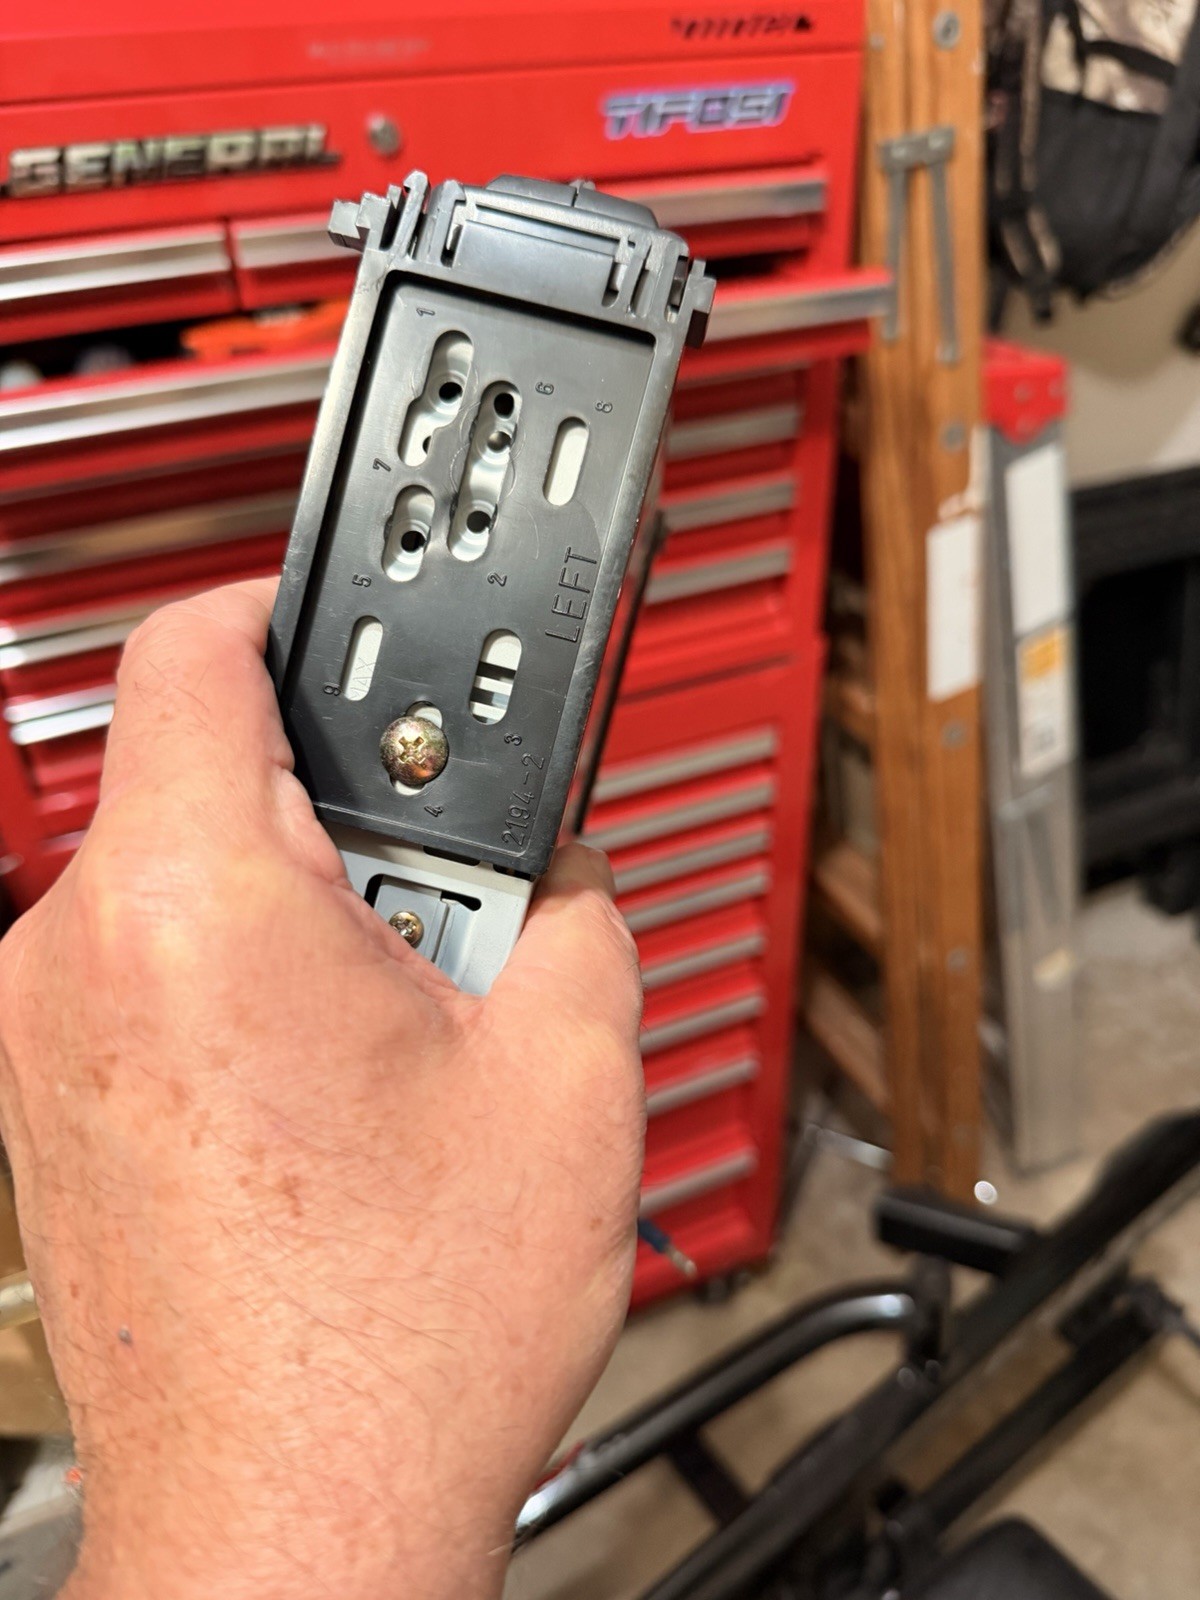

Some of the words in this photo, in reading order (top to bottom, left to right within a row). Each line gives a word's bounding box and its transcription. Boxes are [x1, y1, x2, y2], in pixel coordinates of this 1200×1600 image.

[415, 306, 436, 317] 1
[534, 381, 555, 396] 6
[594, 400, 613, 415] 8
[372, 457, 392, 472] 7
[351, 573, 372, 588] 5
[486, 571, 508, 588] 2
[545, 546, 597, 643] LEFT
[503, 732, 523, 747] 3
[423, 803, 444, 818] 4
